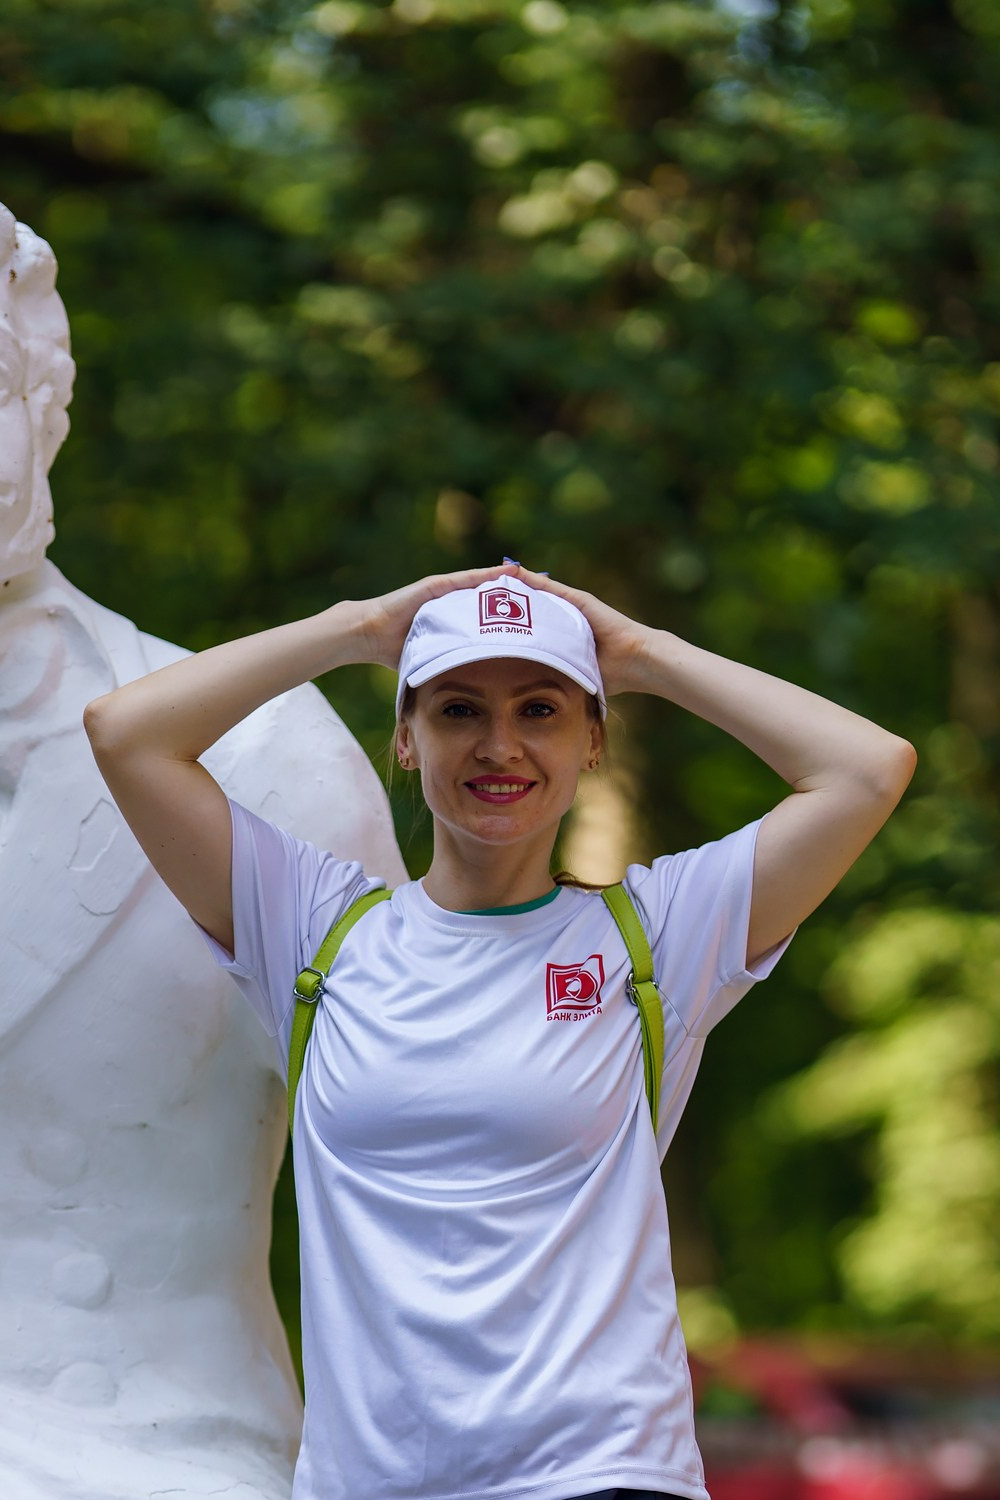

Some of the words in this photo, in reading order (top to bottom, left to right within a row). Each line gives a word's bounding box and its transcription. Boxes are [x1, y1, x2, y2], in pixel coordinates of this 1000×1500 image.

[479, 625, 503, 635] БАНК
[505, 626, 533, 636] ЭЛИТА
[546, 1012, 572, 1022] БАНК
[573, 1006, 603, 1022] ЭЛИТА
